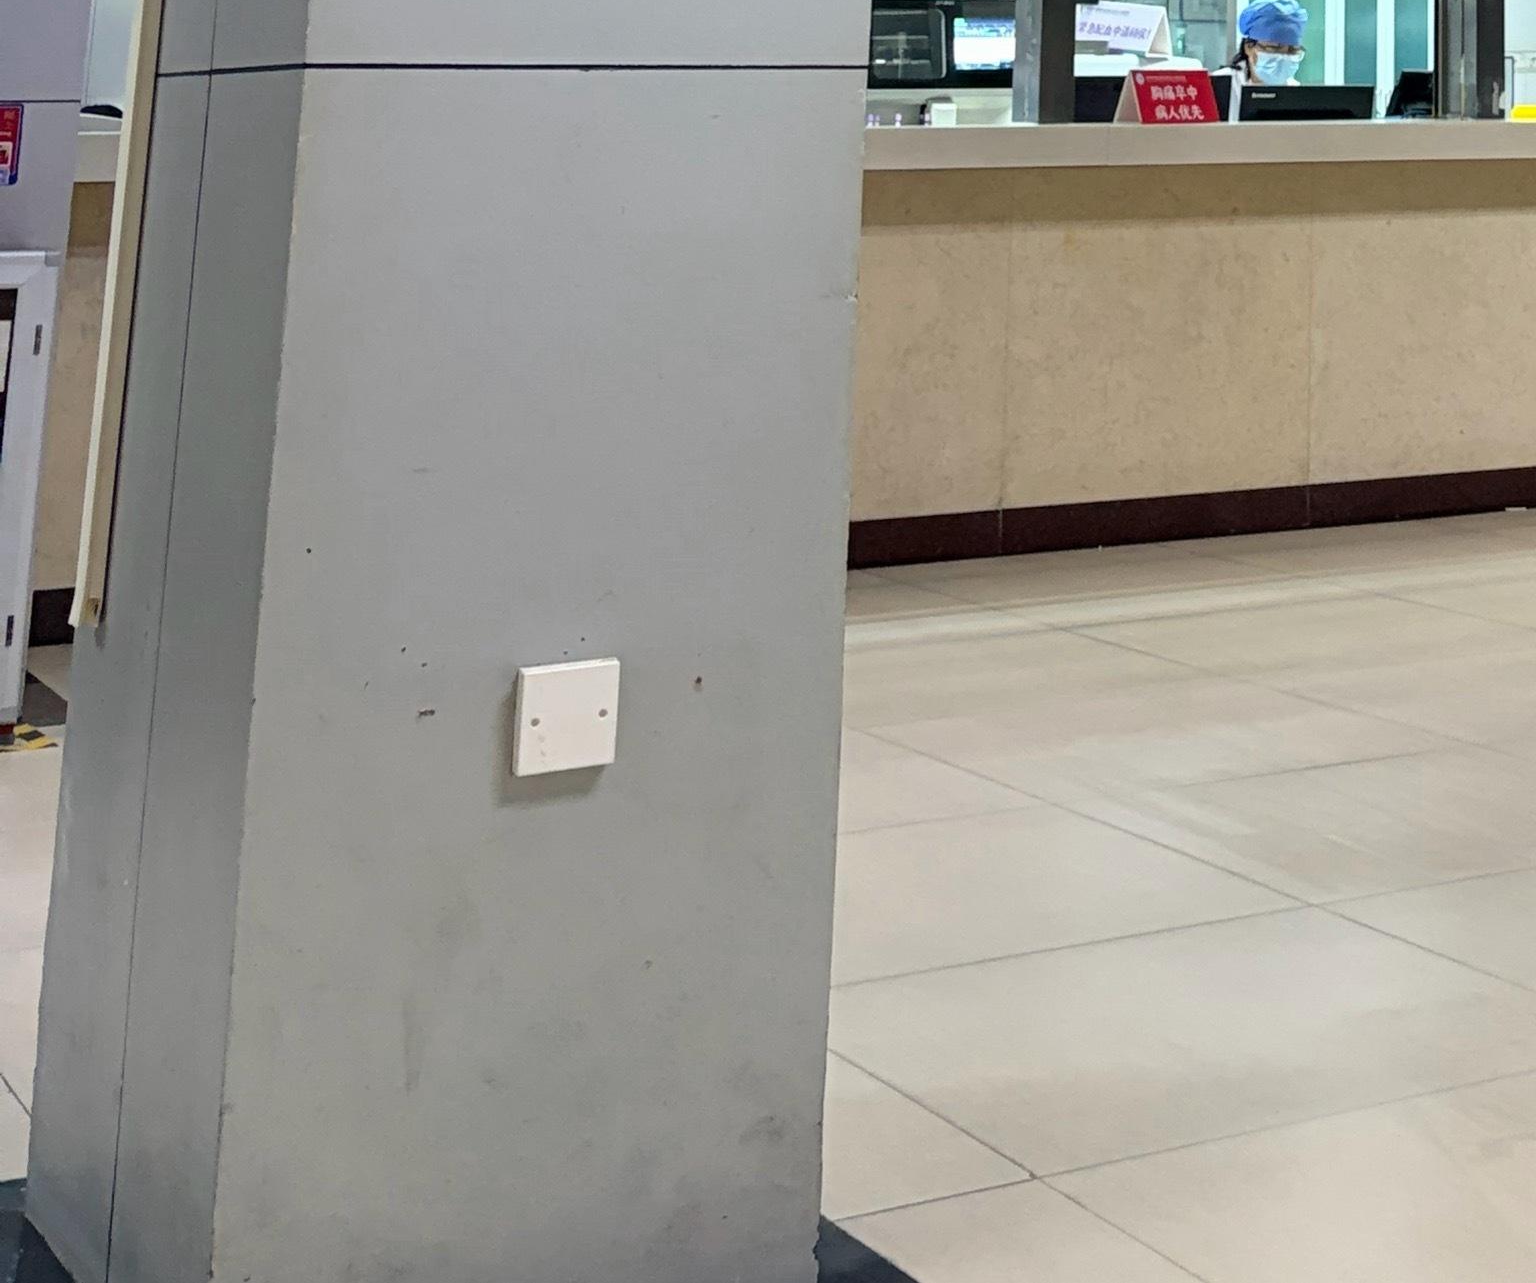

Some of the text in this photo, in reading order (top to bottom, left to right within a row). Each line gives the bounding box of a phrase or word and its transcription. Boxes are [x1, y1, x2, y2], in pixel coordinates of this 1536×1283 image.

[1150, 84, 1198, 101] 胸痛卒中
[1155, 104, 1204, 120] 病人优先
